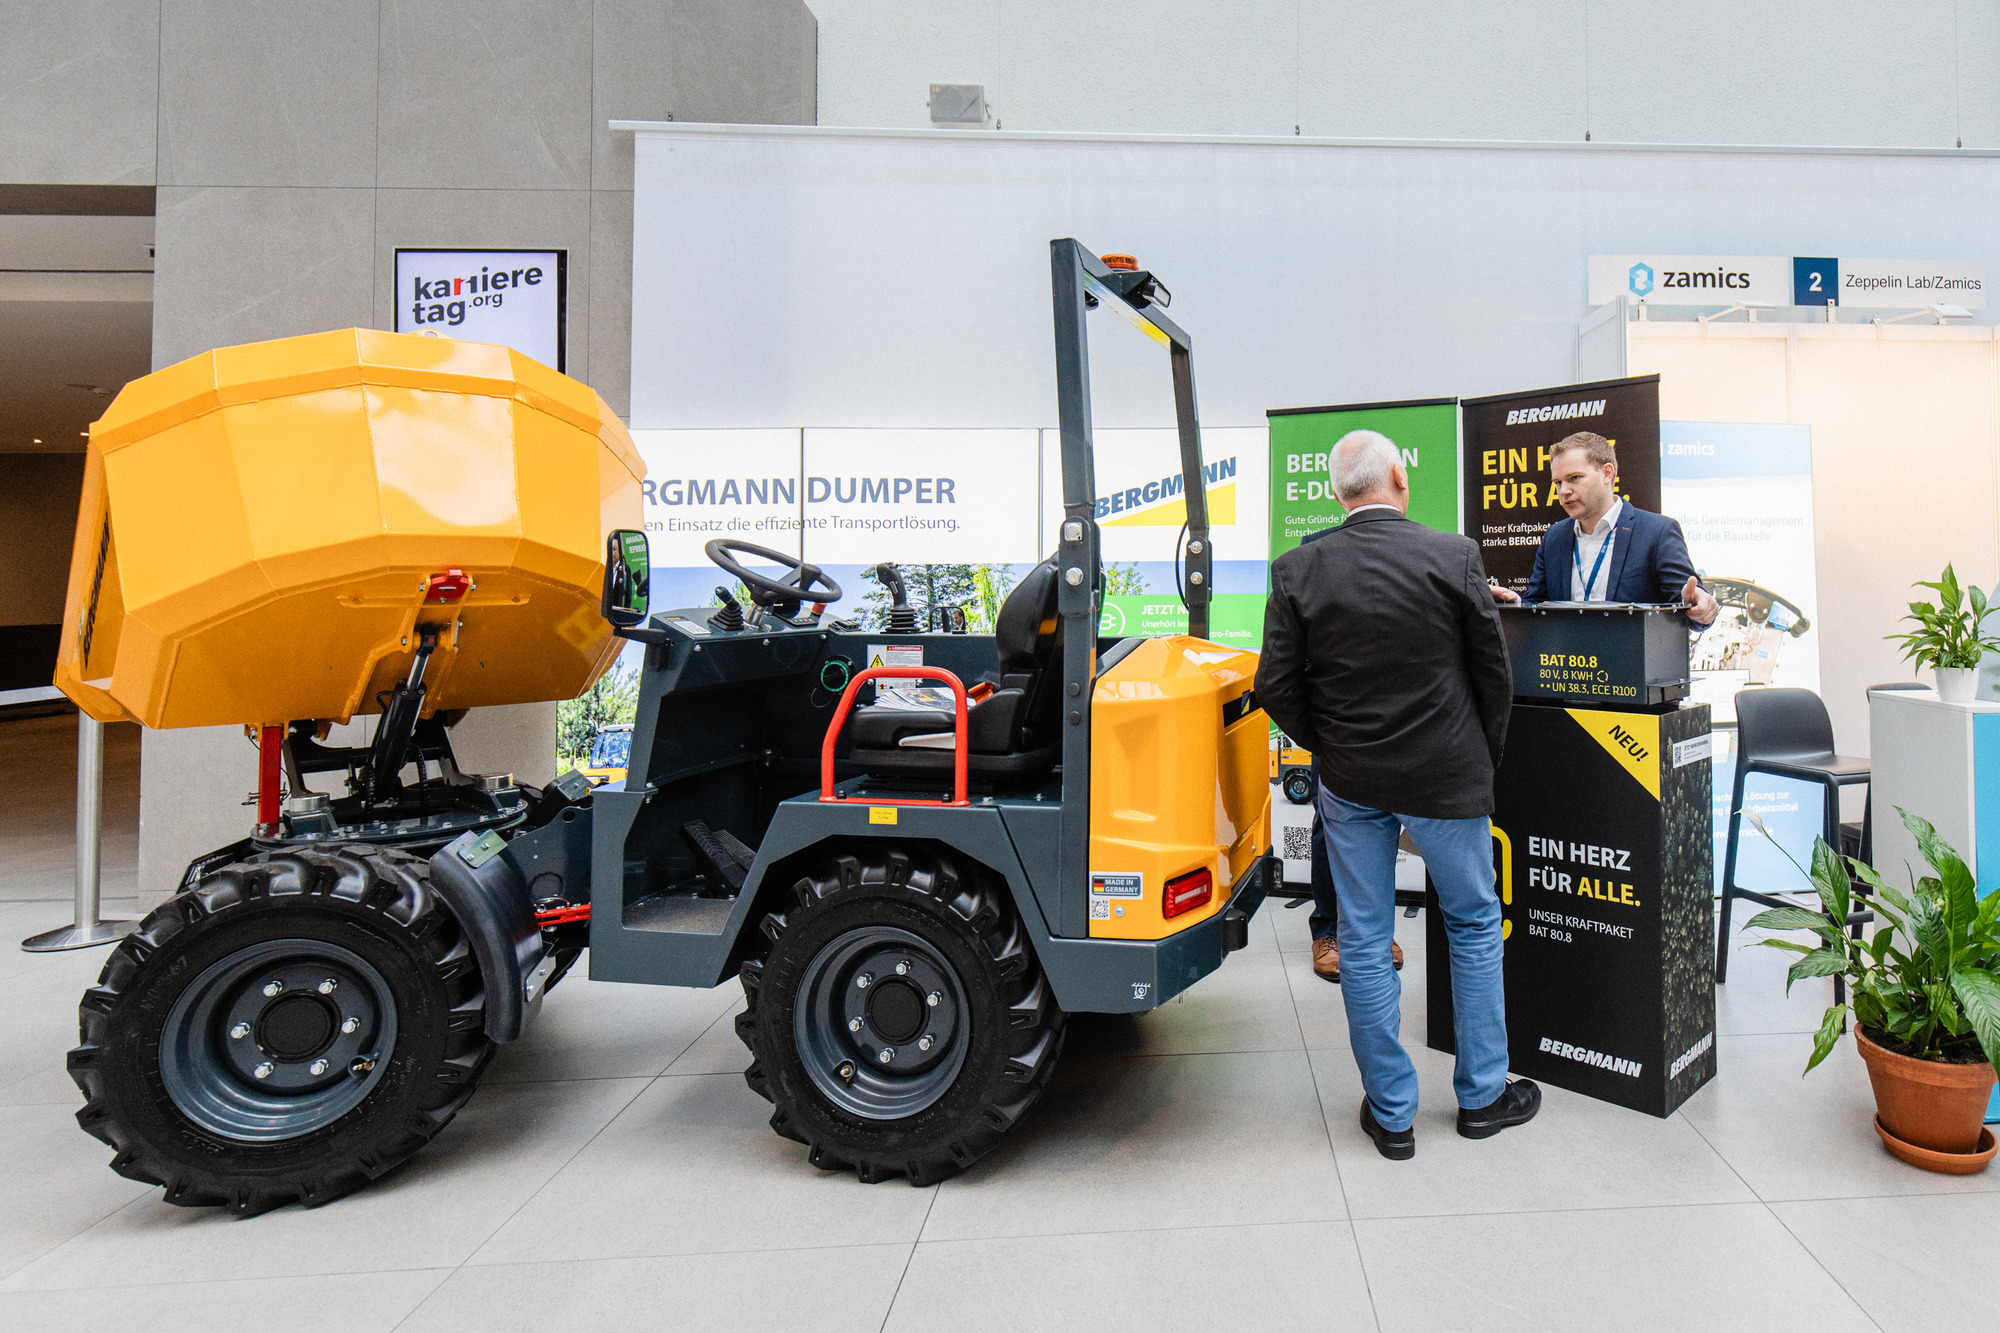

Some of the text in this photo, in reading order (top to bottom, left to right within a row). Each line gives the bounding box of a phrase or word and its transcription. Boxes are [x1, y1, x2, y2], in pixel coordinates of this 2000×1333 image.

[413, 265, 543, 302] karriere
[1663, 267, 1751, 289] zamics
[1808, 271, 1823, 292] 2
[1845, 274, 1982, 292] Zeppelin Lab/Zamics
[412, 292, 503, 326] tag .org
[1505, 399, 1607, 426] BERGMANN
[1667, 442, 1715, 456] zamics
[1482, 447, 1528, 475] EIN
[642, 476, 956, 505] RGMANN DUMPER
[1093, 456, 1237, 519] BERGMNN
[1286, 480, 1336, 501] E-DU
[1482, 477, 1538, 510] FÜR
[668, 518, 723, 532] Einsatz
[727, 517, 751, 531] die
[755, 515, 828, 531] effiziente
[831, 515, 961, 533] Transportlösung.
[1284, 515, 1306, 525] Gute
[1307, 514, 1340, 524] Gründe
[1482, 524, 1506, 534] Unser
[1701, 514, 1805, 528] Gerätemanagement
[1482, 536, 1545, 547] starke BERGM
[1704, 530, 1721, 542] die
[1723, 530, 1773, 542] Baustelle
[1141, 604, 1176, 615] JETZT
[1141, 620, 1176, 628] Unerhört
[1539, 653, 1598, 668] BAT 80.8
[1539, 669, 1593, 681] 80 V, 8 KWH
[1552, 682, 1637, 697] UN 38.3, ECE R100
[1608, 724, 1649, 762] NEU!
[1744, 791, 1775, 802] Lösung
[1776, 791, 1790, 800] zur
[1528, 835, 1631, 872] EIN HERZ
[1528, 865, 1641, 907] FÜR ALLE.
[1528, 908, 1634, 940] UNSER KRAFTPAKET
[1528, 924, 1573, 943] BAT 80.8
[1539, 1036, 1643, 1078] BERGMANN
[1669, 1031, 1713, 1081] BERGMANN
